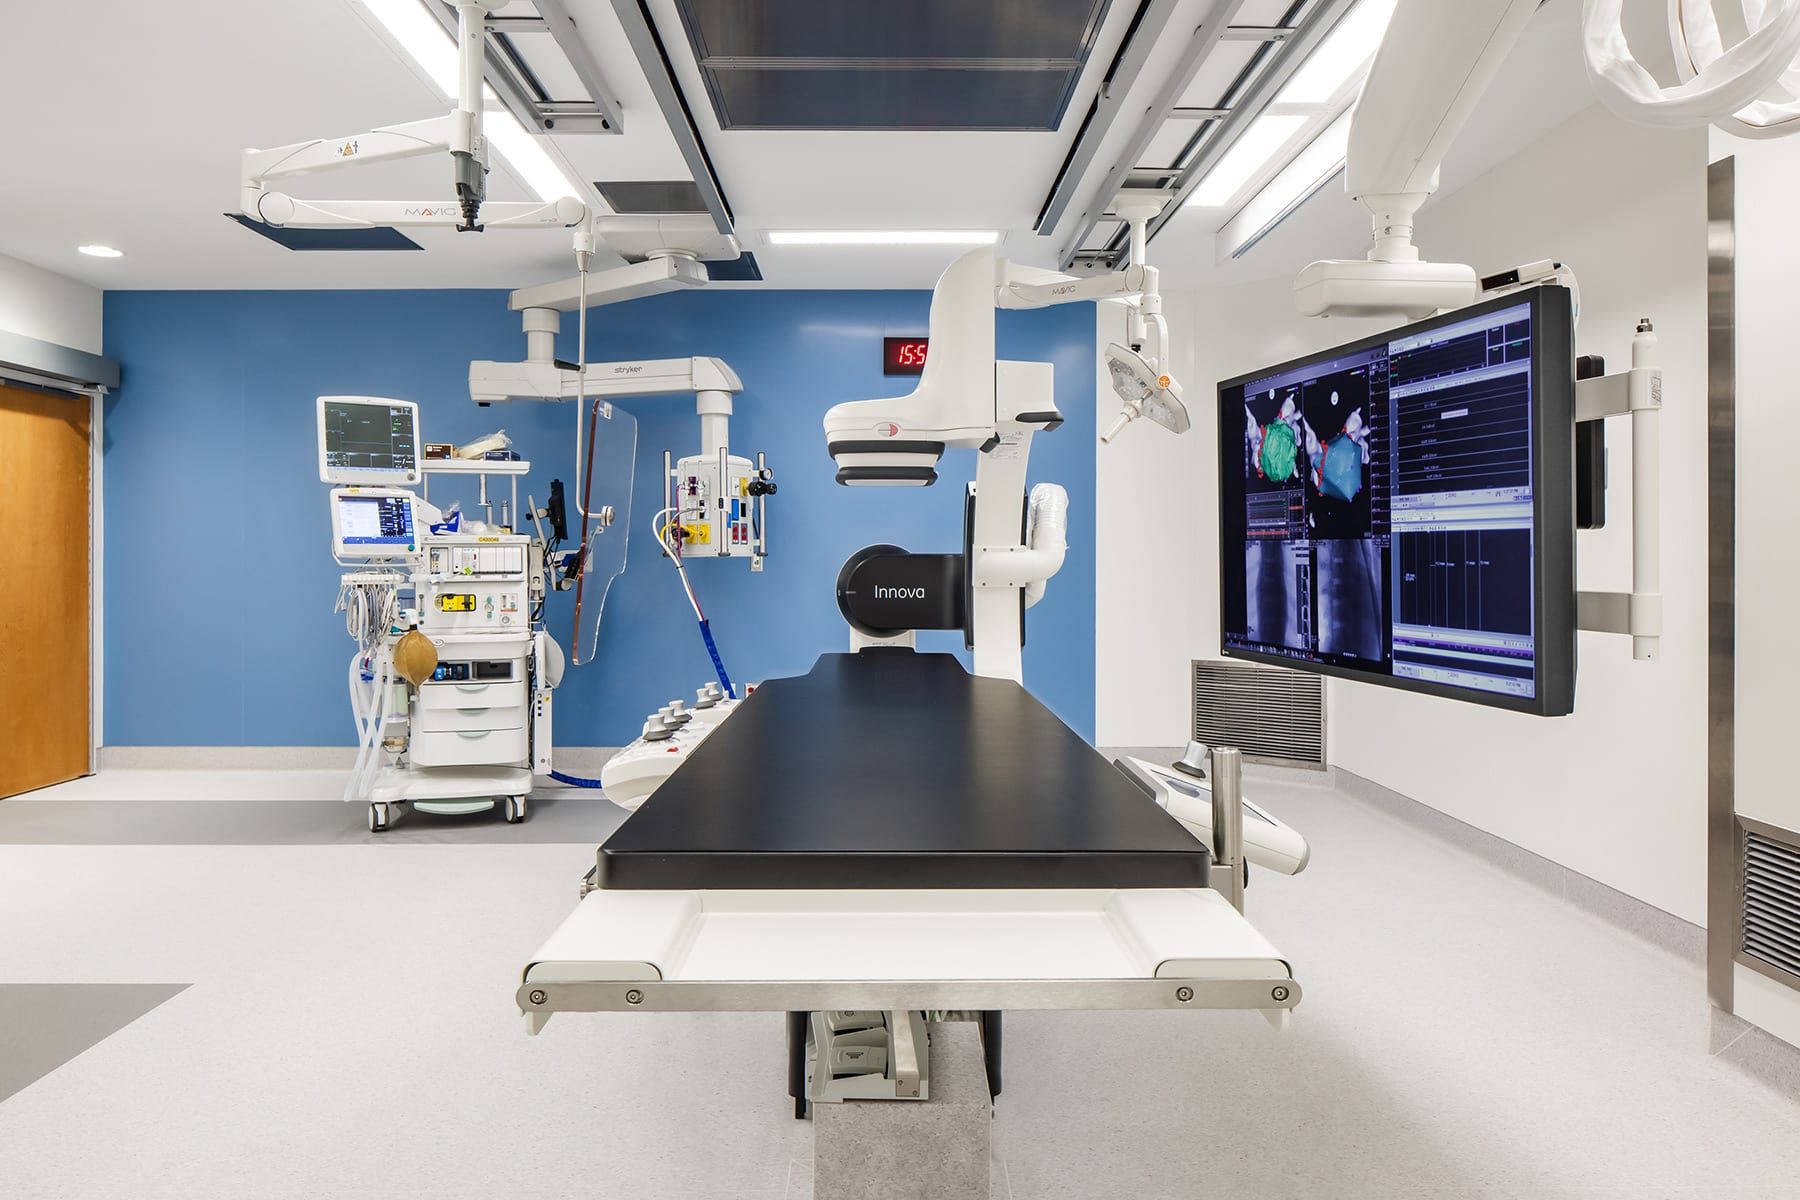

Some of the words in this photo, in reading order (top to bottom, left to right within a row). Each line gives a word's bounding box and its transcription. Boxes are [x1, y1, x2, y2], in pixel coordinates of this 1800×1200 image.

[404, 207, 457, 216] MAVIG
[899, 345, 926, 364] 15:5
[614, 366, 642, 374] stryker
[874, 584, 925, 599] Innova
